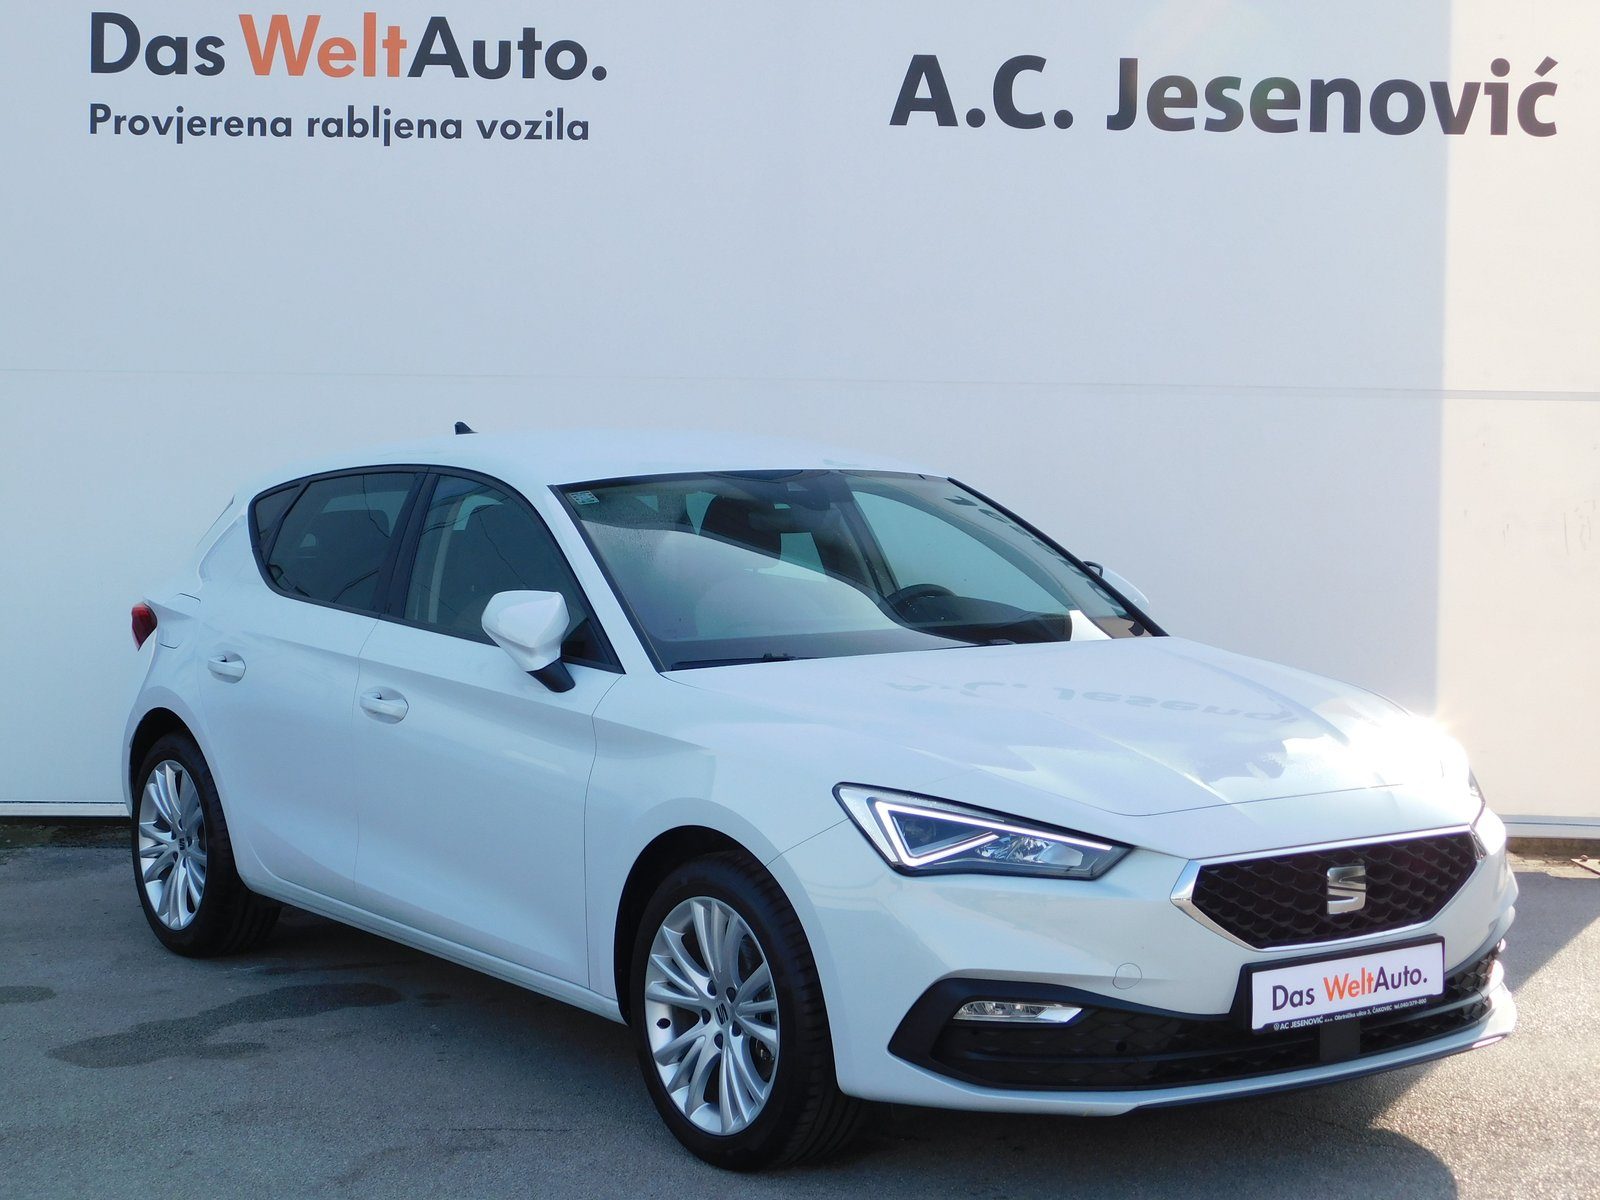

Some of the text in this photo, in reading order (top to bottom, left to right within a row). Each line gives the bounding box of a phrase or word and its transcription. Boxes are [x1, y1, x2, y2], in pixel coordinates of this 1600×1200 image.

[90, 11, 608, 82] Das WeltAuto.
[888, 54, 1559, 138] A.C. Jesenović
[89, 102, 590, 147] Provjerena rabljena vozila
[1272, 965, 1428, 1011] Das WeltAuto.
[1279, 1022, 1290, 1030] AC
[1290, 1015, 1324, 1029] JESENOVIĆ
